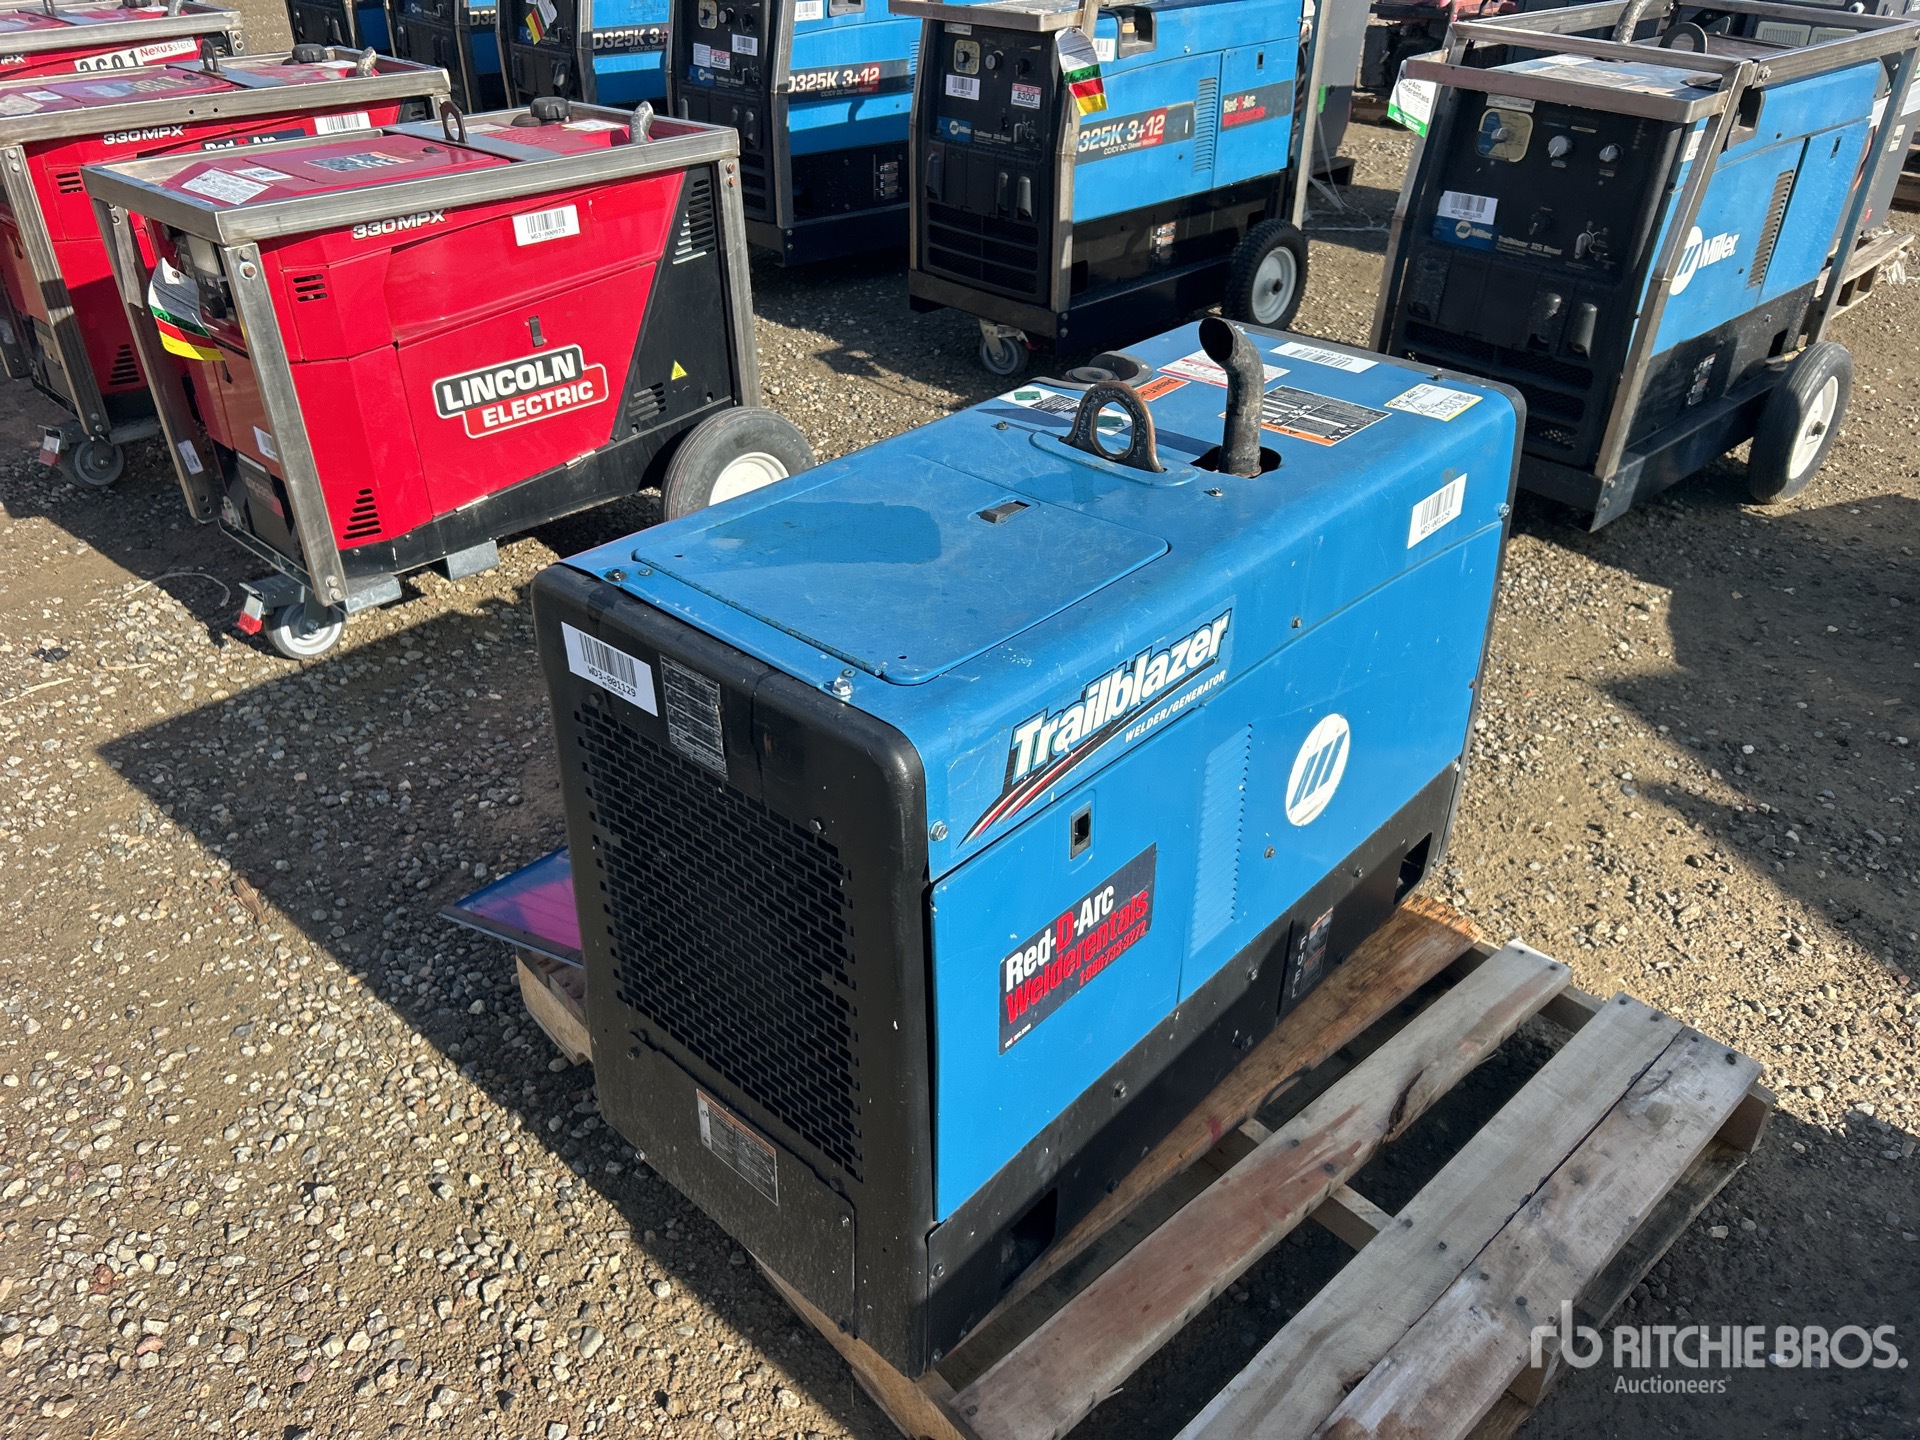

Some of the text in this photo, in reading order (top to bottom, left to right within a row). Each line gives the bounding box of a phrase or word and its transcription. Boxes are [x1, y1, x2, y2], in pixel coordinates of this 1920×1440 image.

[592, 29, 646, 50] D325K
[842, 67, 880, 88] 3+12
[1017, 92, 1035, 103] $300
[103, 125, 185, 146] 330MPX
[1076, 114, 1166, 154] 325K 3+12
[352, 208, 446, 240] 330MPX
[1698, 232, 1740, 269] Miller
[442, 352, 577, 411] LINCOLN
[481, 381, 594, 429] ELECTRIC
[587, 665, 637, 697] WD3-001129
[1013, 615, 1230, 781] Trailblazer
[1125, 670, 1227, 743] WELDER/GENERATOR
[1005, 890, 1149, 1024] Welderentals
[1006, 885, 1114, 992] Red-D-Arc
[1291, 935, 1308, 999] FUEL
